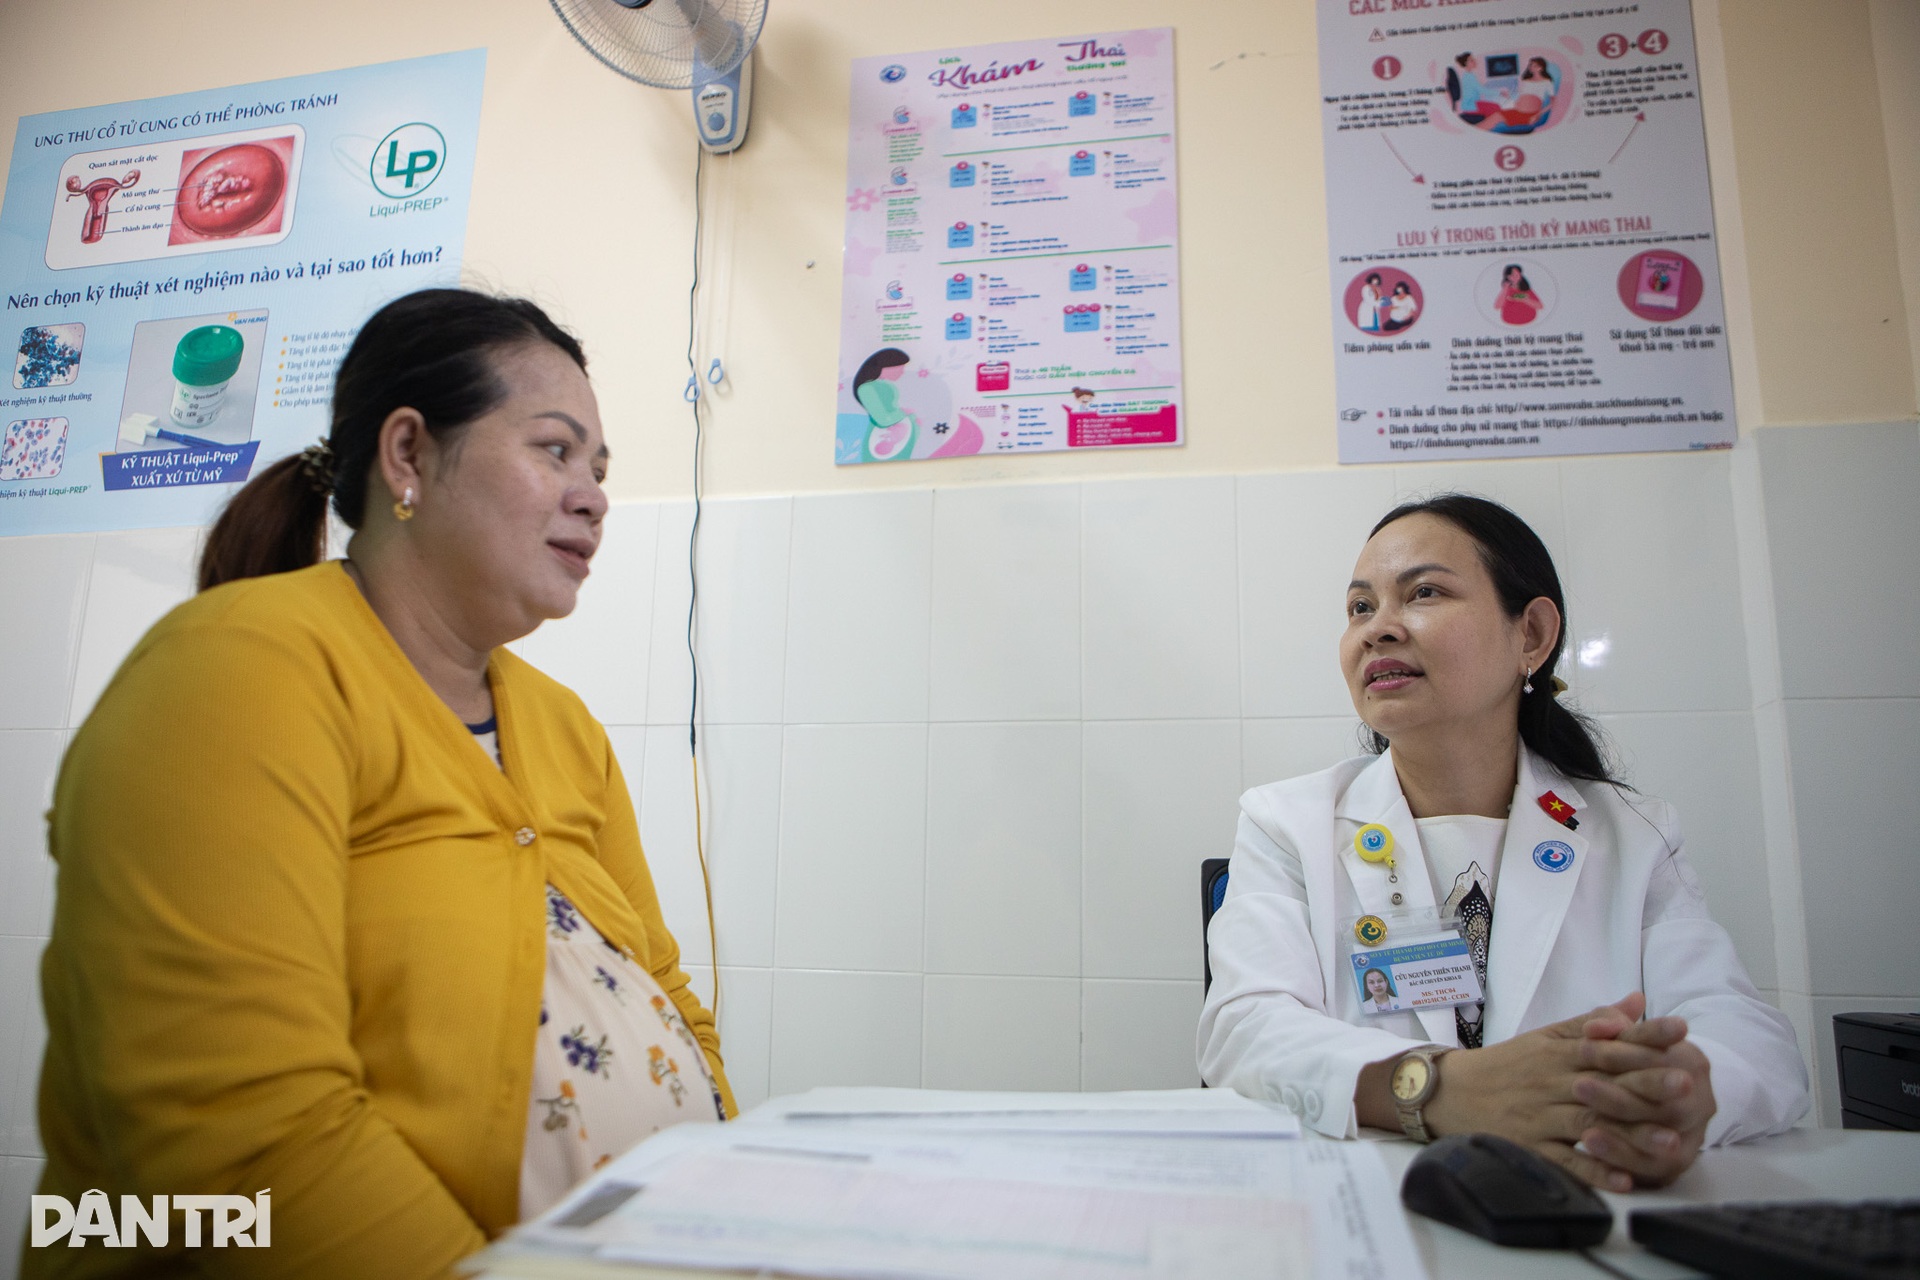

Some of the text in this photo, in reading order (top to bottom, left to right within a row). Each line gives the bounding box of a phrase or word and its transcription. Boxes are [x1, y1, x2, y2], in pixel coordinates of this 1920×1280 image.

[1058, 40, 1125, 62] Thai
[1606, 36, 1620, 56] 3
[1644, 32, 1661, 52] 4
[928, 58, 1044, 90] Khám
[1382, 59, 1392, 78] 1
[35, 93, 338, 147] UNG THƯ CỔ TỬ CUNG CÓ THỂ PHÒNG TRÁNH
[1502, 149, 1517, 169] 2
[1397, 232, 1426, 247] LƯU
[1445, 226, 1495, 242] TRONG
[1500, 220, 1536, 240] THỜI
[1566, 218, 1611, 236] MANG
[1616, 215, 1652, 232] THAI
[7, 246, 443, 310] Nên chọn kỹ thuật xét nghiệm nào và tại sao tốt hơn?
[122, 451, 239, 469] KỸ THUẬT Liqui-Prep
[131, 467, 223, 486] XUẤT XỨ TỪ MỸ
